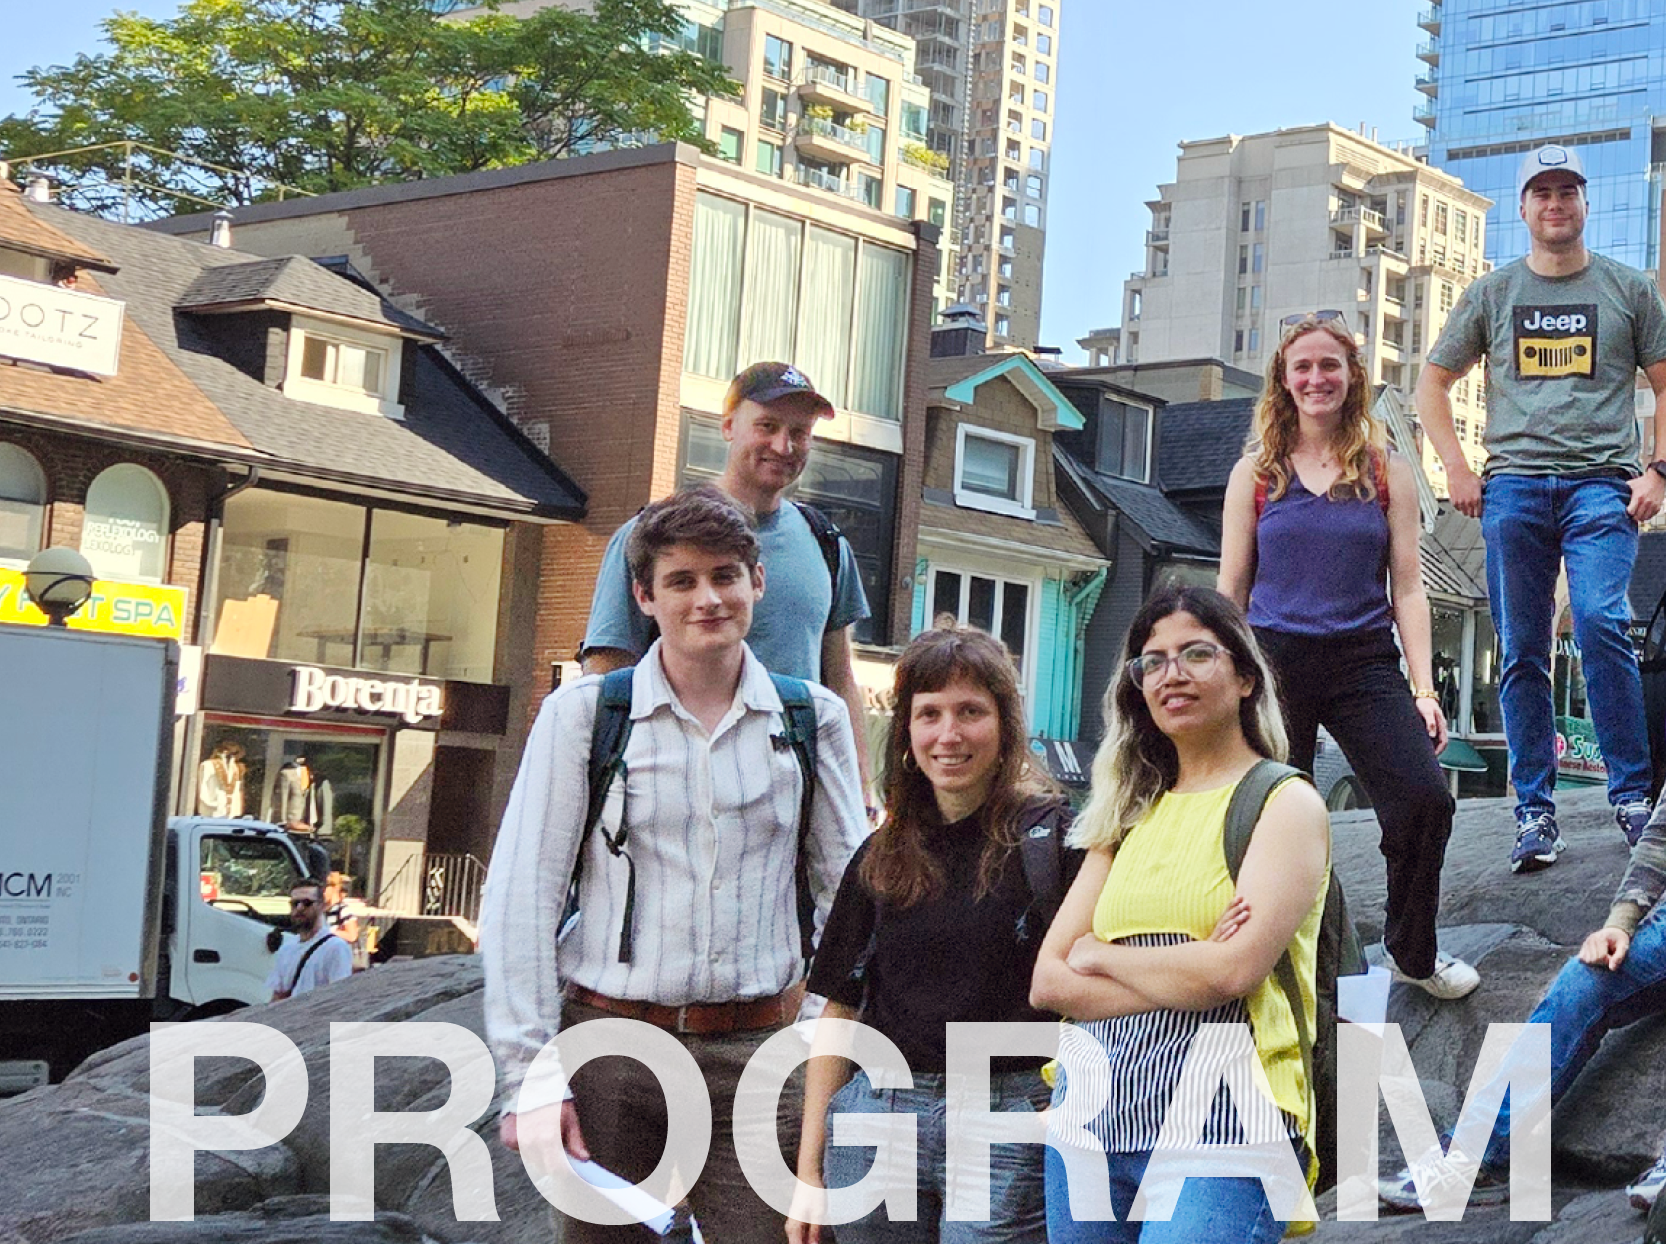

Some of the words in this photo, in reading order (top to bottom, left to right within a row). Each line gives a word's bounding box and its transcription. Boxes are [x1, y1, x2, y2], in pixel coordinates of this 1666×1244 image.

[112, 599, 175, 628] SPA
[288, 666, 443, 724] Borenta
[0, 872, 52, 897] CM
